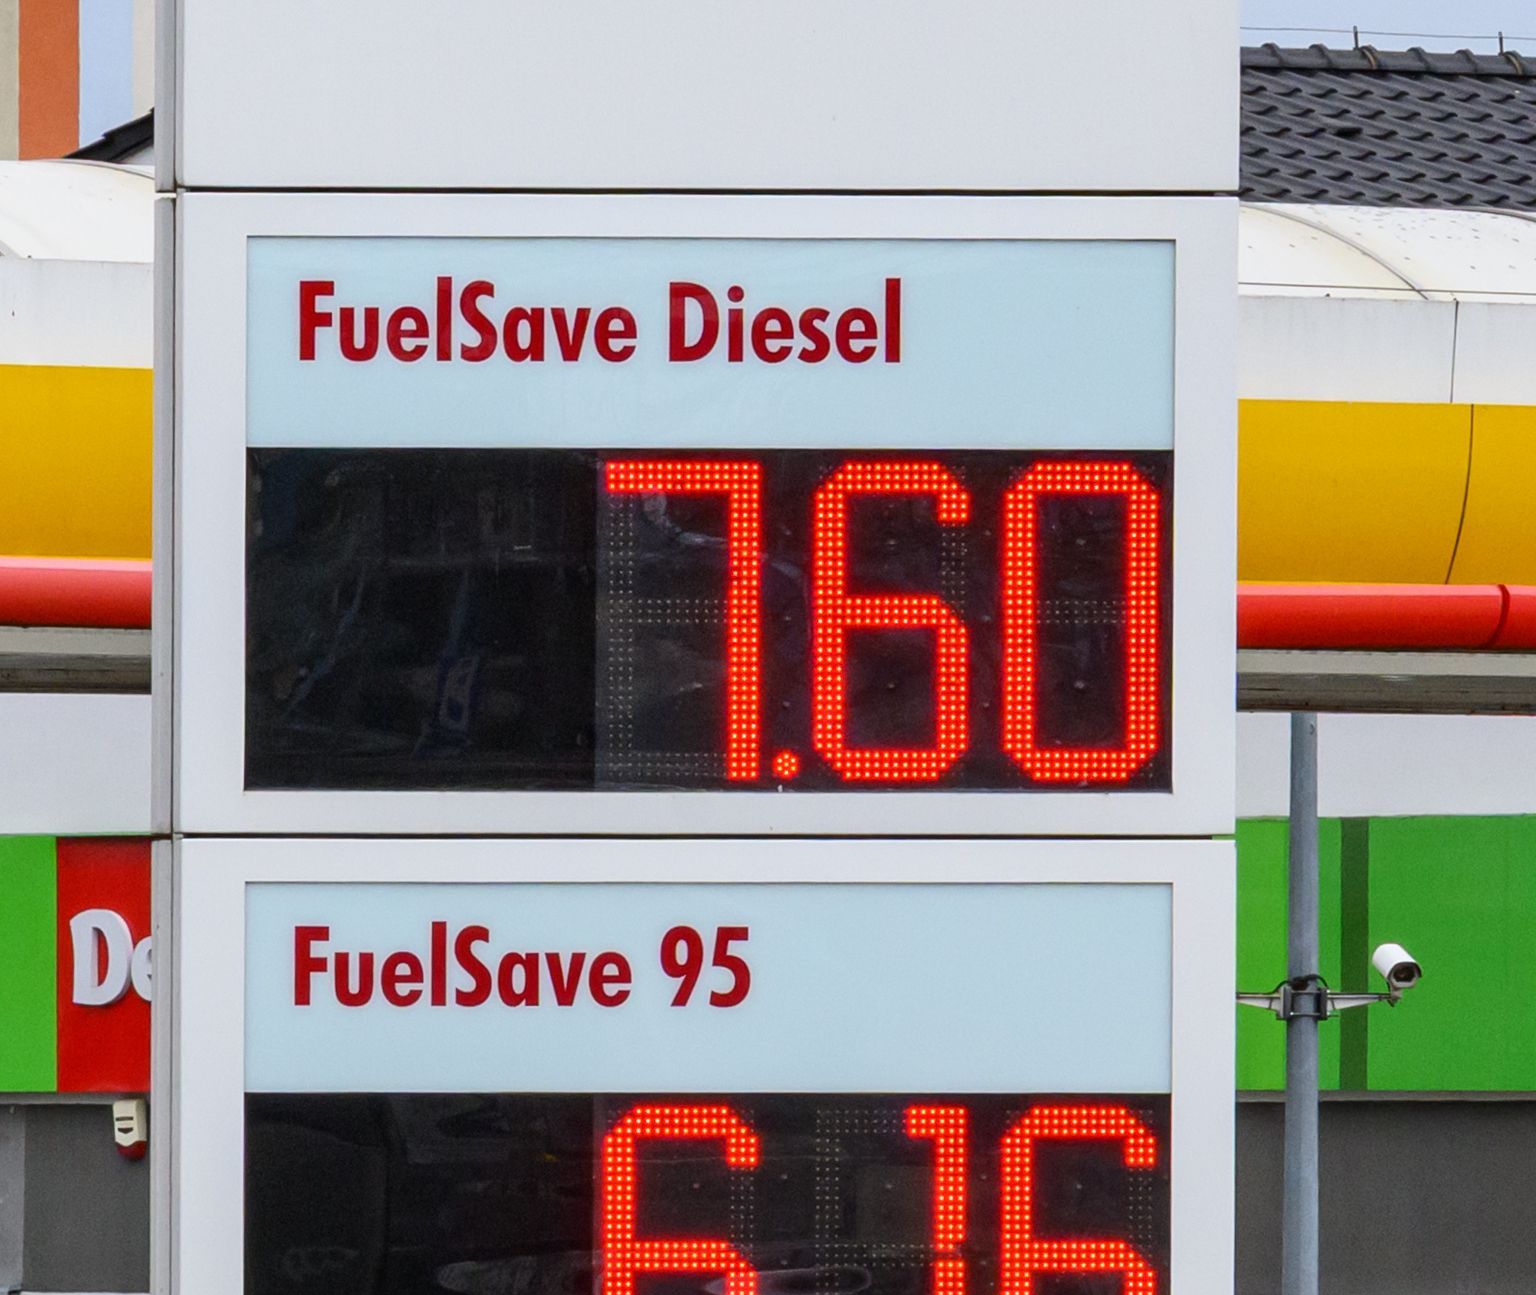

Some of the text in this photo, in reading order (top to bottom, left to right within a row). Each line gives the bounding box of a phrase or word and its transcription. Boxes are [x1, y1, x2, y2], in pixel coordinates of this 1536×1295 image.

[300, 277, 902, 363] FuelSave Diesel
[604, 460, 1162, 783] 7.60
[293, 921, 752, 1007] FuelSave 95
